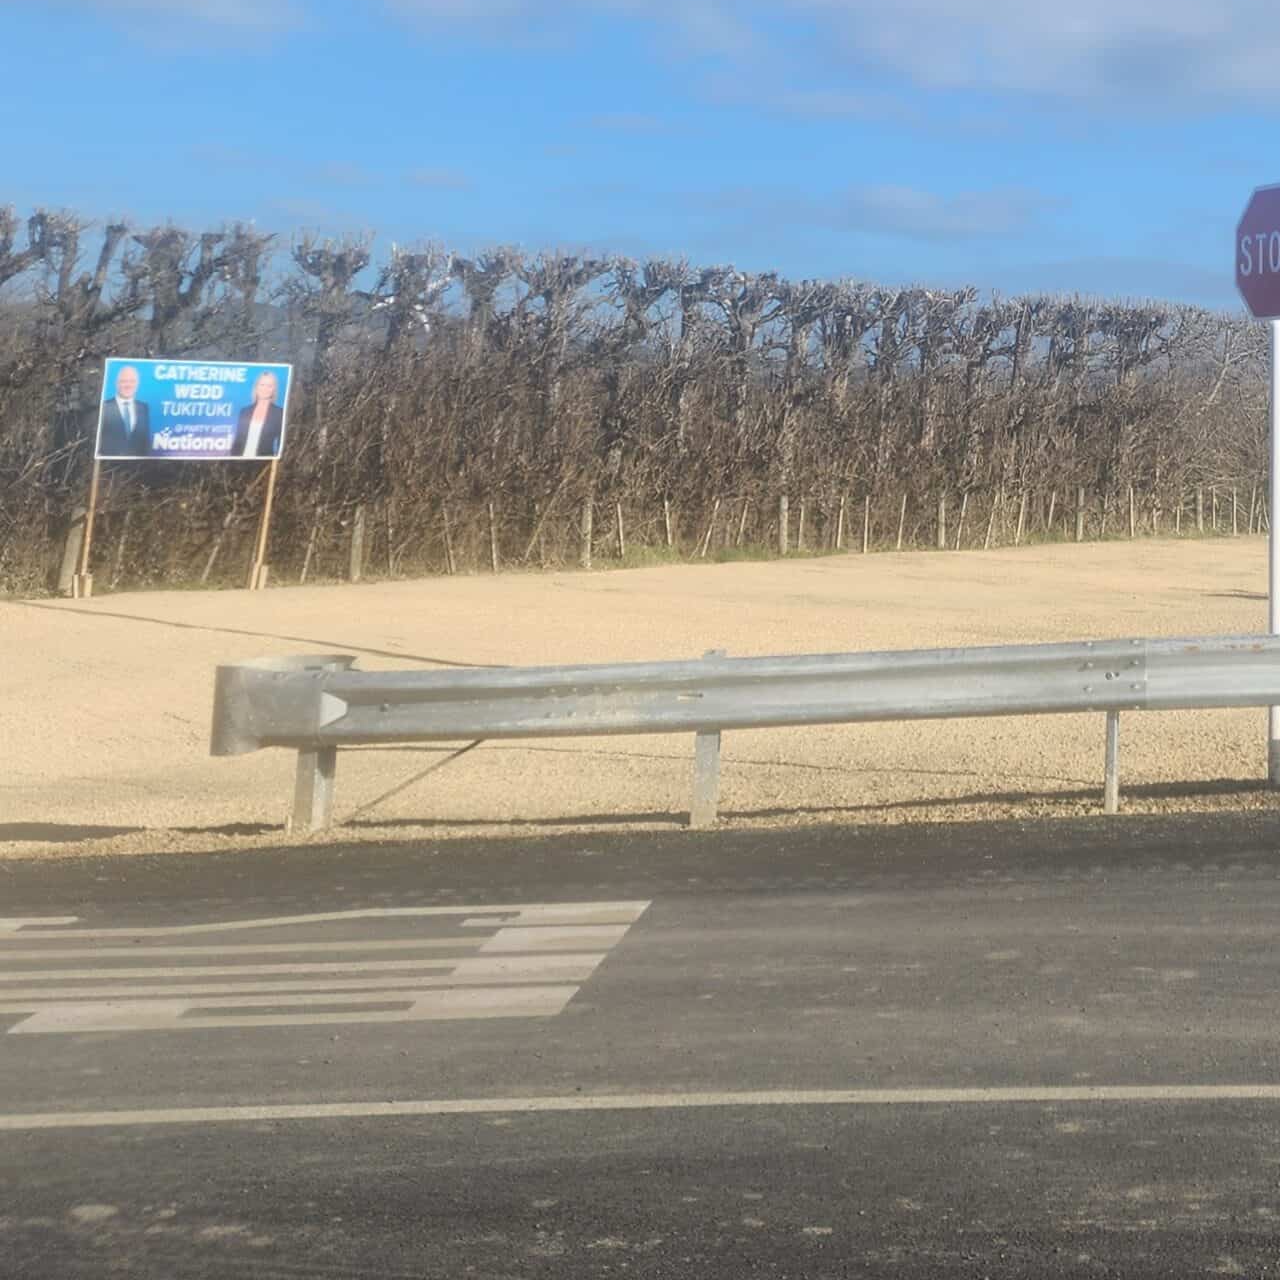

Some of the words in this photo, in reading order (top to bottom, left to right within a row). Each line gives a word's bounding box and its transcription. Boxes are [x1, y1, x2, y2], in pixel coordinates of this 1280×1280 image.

[155, 365, 247, 382] CATHERINE
[175, 384, 223, 400] WEDD
[162, 401, 232, 417] TUKITUKI
[152, 432, 234, 450] National
